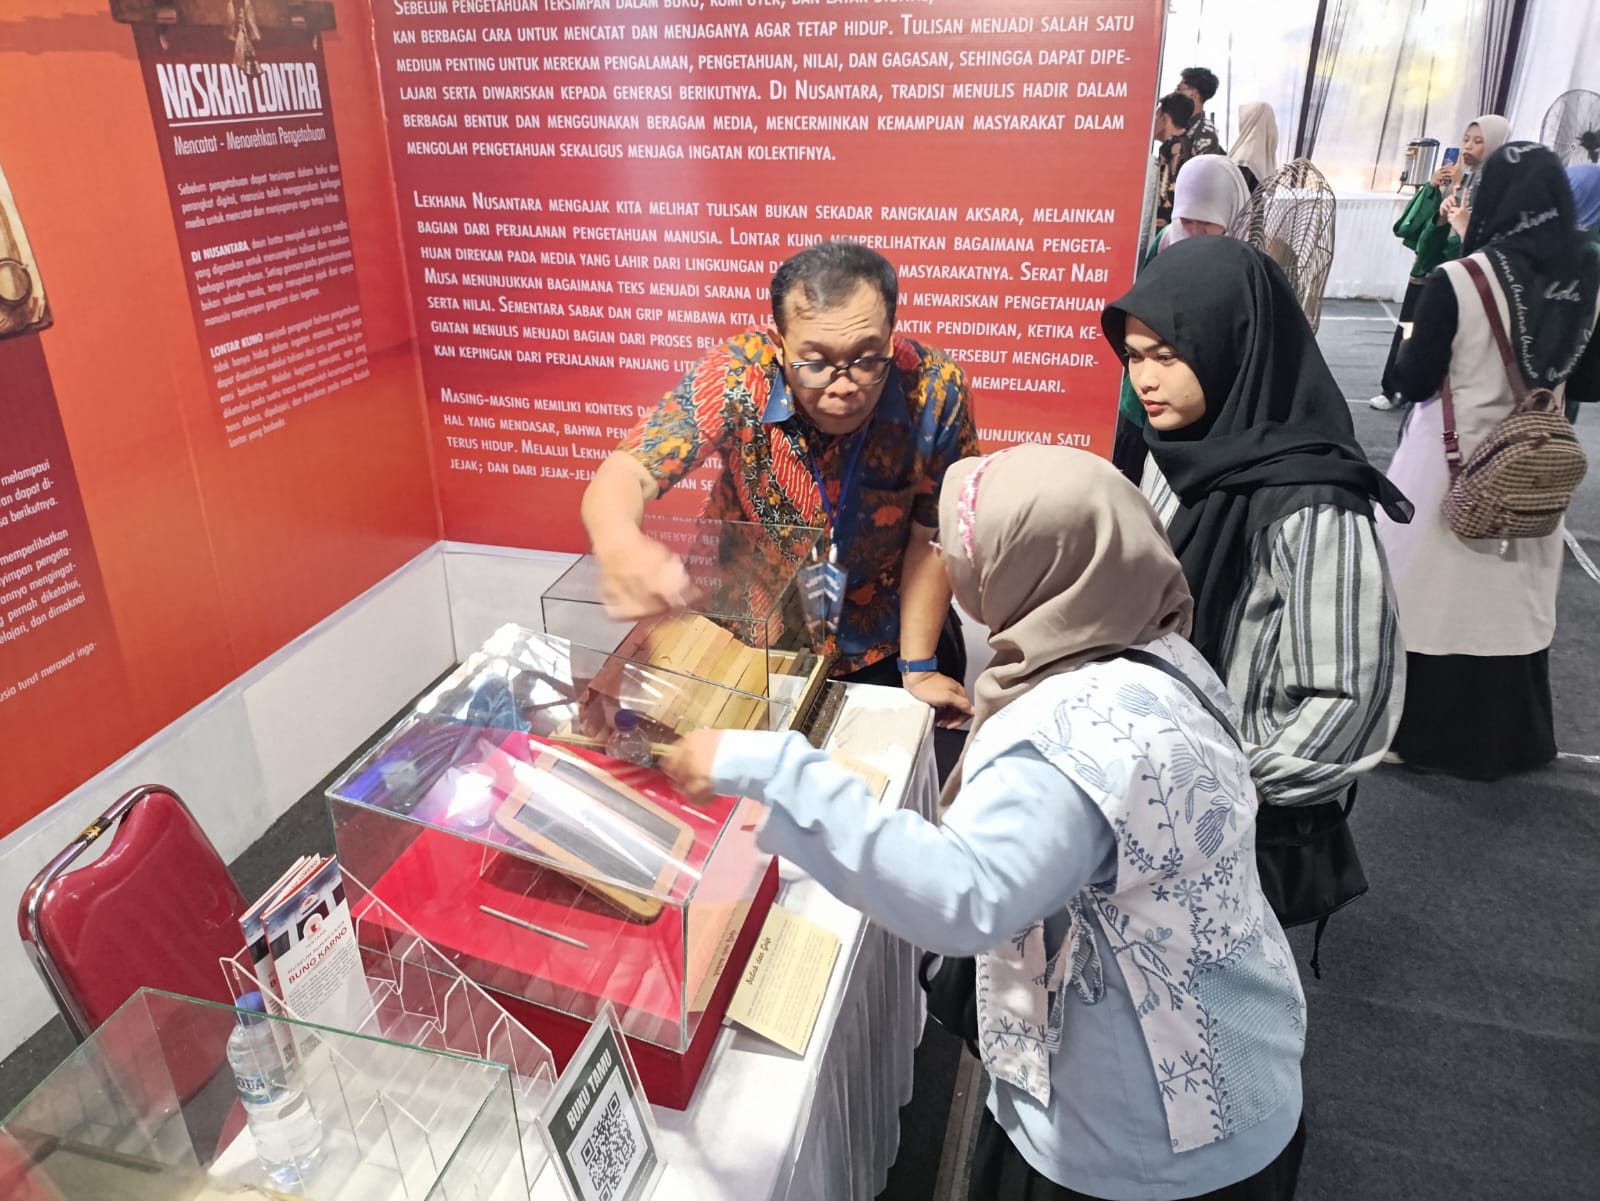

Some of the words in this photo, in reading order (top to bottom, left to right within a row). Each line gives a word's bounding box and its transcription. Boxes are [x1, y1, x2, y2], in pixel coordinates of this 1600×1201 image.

[394, 0, 448, 15] SEBELUM
[453, 0, 538, 13] PENGETAHUAN
[393, 30, 416, 44] KAN
[421, 29, 476, 43] BERBAGAI
[482, 28, 512, 42] CARA
[517, 27, 558, 41] UNTUK
[564, 25, 626, 40] MENCATAT
[632, 25, 658, 40] DAN
[664, 23, 749, 39] MENJAGANYA
[754, 22, 791, 38] AGAR
[796, 21, 838, 37] TETAP
[844, 20, 894, 36] HIDUP.
[901, 14, 963, 35] TULISAN
[970, 17, 1034, 33] MENJADI
[1041, 16, 1088, 32] SALAH
[1096, 16, 1134, 31] SATU
[396, 58, 442, 72] MEDIUM
[445, 57, 496, 71] PENTING
[498, 57, 540, 71] UNTUK
[544, 56, 600, 70] MEREKAM
[604, 56, 694, 72] PENGALAMAN,
[698, 54, 798, 71] PENGETAHUAN,
[803, 53, 844, 71] NILAI,
[849, 52, 877, 68] DAN
[882, 52, 954, 70] GAGASAN,
[960, 50, 1033, 66] SEHINGGA
[1038, 50, 1086, 65] DAPAT
[1090, 49, 1131, 64] DIPE-
[156, 63, 253, 119] NASKAH
[253, 62, 322, 112] LONTAR
[400, 86, 436, 100] LAJARI
[442, 86, 477, 100] SERTA
[482, 86, 554, 100] DIWARISKAN
[560, 86, 607, 100] KEPADA
[613, 86, 672, 100] GENERASI
[680, 85, 762, 100] BERIKUTNYA.
[770, 79, 787, 100] DI
[795, 80, 883, 102] NUSANTARA,
[891, 84, 944, 99] TRADISI
[952, 83, 1015, 98] MENULIS
[1023, 82, 1068, 98] HADIR
[1077, 82, 1127, 97] DALAM
[174, 135, 218, 155] Mencatat
[226, 129, 277, 150] Menorehkan
[278, 124, 326, 147] Pengetahuan
[413, 191, 467, 208] LEKHANA
[472, 192, 543, 211] NUSANTARA
[549, 199, 610, 213] MENGAJAK
[616, 200, 642, 214] KITA
[650, 202, 700, 216] MELIHAT
[706, 203, 757, 217] TULISAN
[766, 204, 807, 218] BUKAN
[815, 205, 872, 220] SEKADAR
[881, 206, 958, 221] RANGKAIAN
[965, 208, 1024, 225] AKSARA,
[1032, 208, 1115, 223] MELAINKAN
[417, 221, 458, 234] BAGIAN
[464, 222, 490, 235] DARI
[496, 224, 566, 238] PERJALANAN
[572, 227, 657, 242] PENGETAHUAN
[664, 230, 723, 244] MANUSIA.
[730, 227, 780, 246] LONTAR
[787, 234, 822, 247] KUNO
[954, 237, 1034, 252] BAGAIMANA
[1042, 238, 1111, 253] PENGETA-
[191, 251, 201, 262] DI
[420, 246, 452, 259] HUAN
[455, 248, 504, 262] DIREKAM
[507, 250, 537, 263] PADA
[541, 252, 576, 265] MEDIA
[579, 253, 610, 267] YANG
[614, 255, 649, 268] LAHIR
[653, 256, 680, 270] DARI
[685, 258, 764, 273] LINGKUNGAN
[424, 267, 459, 285] MUSA
[462, 274, 543, 289] MENUNJUKKAN
[547, 278, 614, 292] BAGAIMANA
[617, 281, 645, 294] TEKS
[650, 283, 699, 297] MENJADI
[704, 285, 752, 299] SARANA
[898, 265, 1014, 280] MASYARAKATNYA.
[1020, 262, 1066, 281] SERAT
[1071, 263, 1108, 282] NABI
[427, 296, 460, 309] SERTA
[462, 298, 496, 312] NILAI.
[498, 296, 565, 315] SEMENTARA
[568, 304, 604, 318] SABAK
[608, 306, 632, 319] DAN
[636, 308, 663, 320] GRIP
[668, 310, 726, 324] MEMBAWA
[730, 313, 756, 326] KITA
[913, 293, 998, 308] MEWARISKAN
[1004, 296, 1104, 311] PENGETAHUAN
[896, 320, 932, 334] AKTIK
[936, 321, 1022, 339] PENDIDIKAN,
[1028, 324, 1074, 338] KETIKA
[1080, 326, 1102, 340] KE-
[210, 340, 241, 358] LONTAR
[944, 349, 1008, 363] TERSEBUT
[1012, 352, 1098, 366] MENGHADIR-
[972, 377, 1066, 392] MEMPELAJARI.
[441, 388, 530, 409] MASING-MASING
[534, 399, 581, 412] MEMILIKI
[585, 402, 633, 416] KONTEKS
[444, 414, 464, 426] HAL
[467, 416, 496, 429] YANG
[500, 419, 560, 436] MENDASAR,
[564, 424, 602, 437] BAHWA
[446, 436, 478, 449] TERUS
[481, 440, 518, 453] HIDUP.
[522, 439, 568, 456] MELALUI
[572, 443, 611, 459] LEKHAN
[1057, 433, 1090, 447] SATU
[1, 458, 50, 486] melampaui
[450, 459, 483, 474] JEJAK;
[487, 461, 509, 473] DAN
[512, 464, 536, 476] DARI
[15, 483, 40, 500] dapat
[42, 477, 54, 490] di-
[9, 497, 58, 522] berikutnya.
[0, 529, 68, 565] memperlihatkan
[36, 546, 72, 570] pengeta-
[7, 598, 38, 623] pernah
[30, 614, 47, 628] dan
[48, 592, 86, 619] dimaknai
[18, 673, 38, 690] turut
[40, 652, 76, 678] merawat
[288, 957, 317, 984] BUNG
[317, 926, 348, 958] KARNO
[566, 1087, 591, 1131] BUKU
[588, 1048, 612, 1093] TAMU
